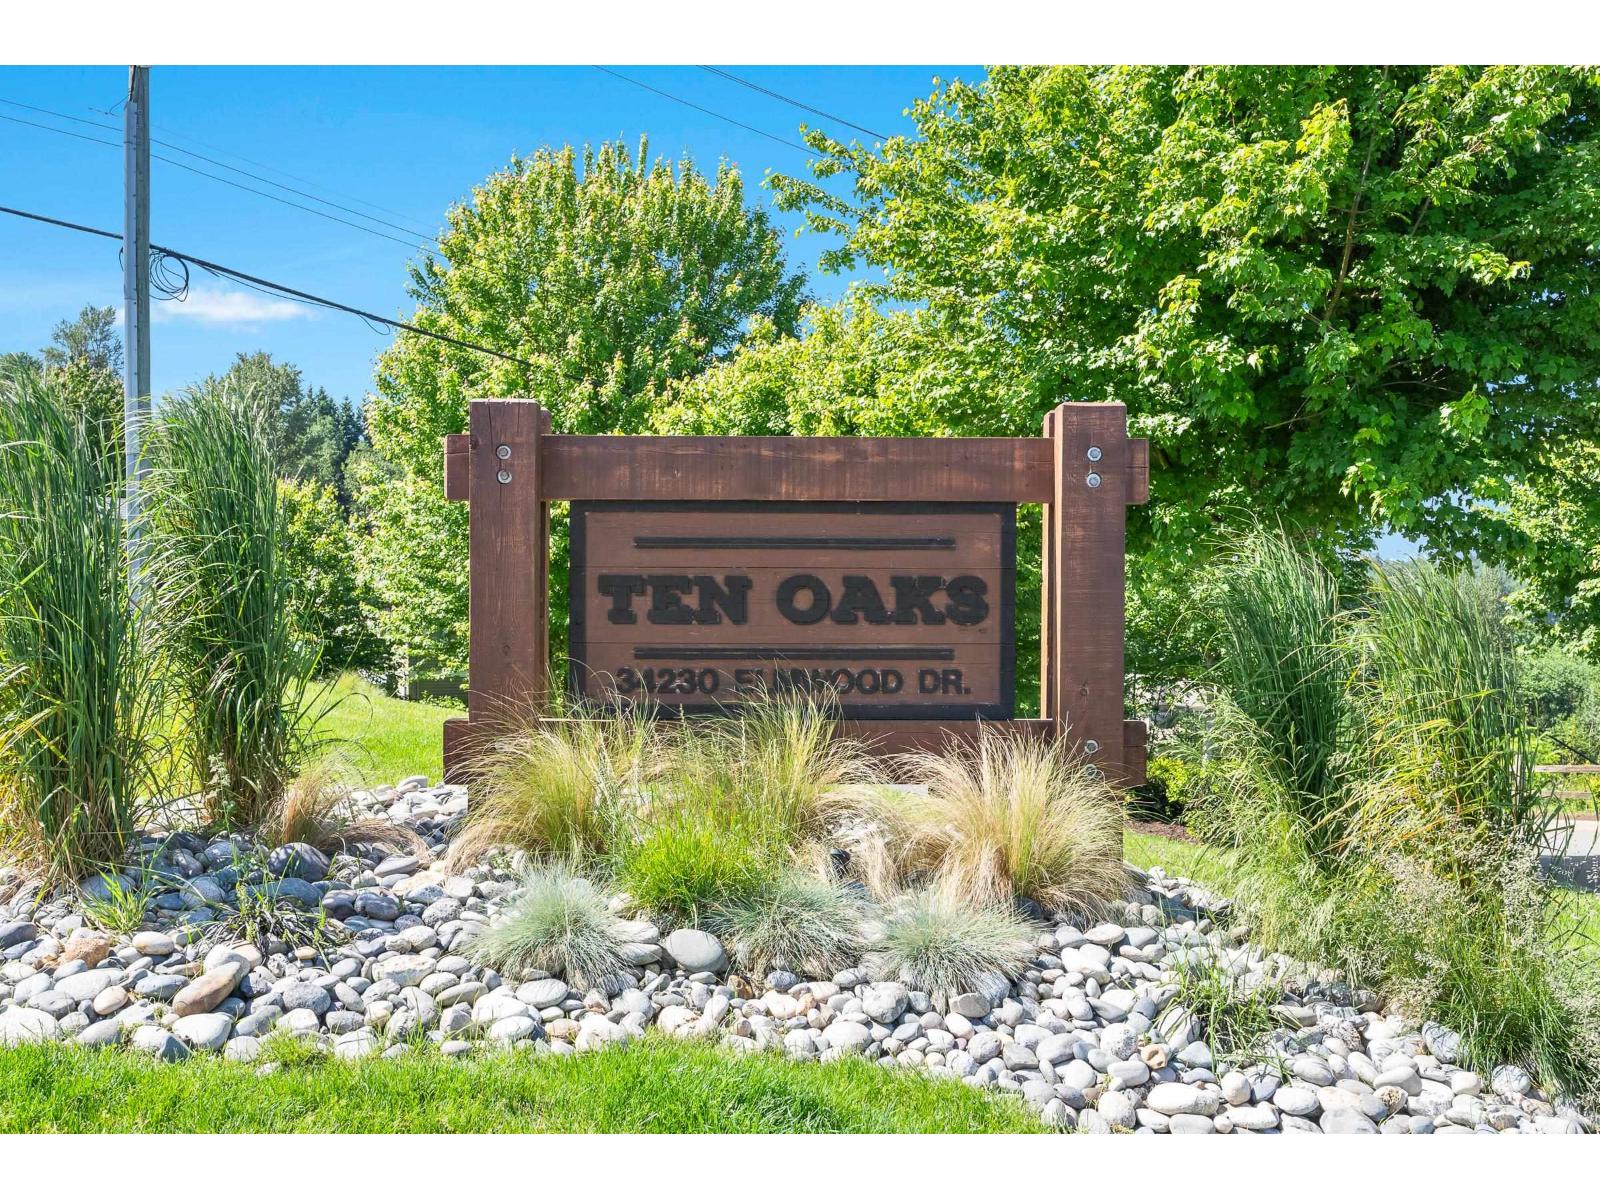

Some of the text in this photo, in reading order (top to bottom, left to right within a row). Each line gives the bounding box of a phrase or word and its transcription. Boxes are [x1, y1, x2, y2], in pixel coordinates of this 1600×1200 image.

[597, 573, 990, 626] TEN OAKS
[615, 667, 720, 695] 34230
[918, 668, 972, 695] DR.
